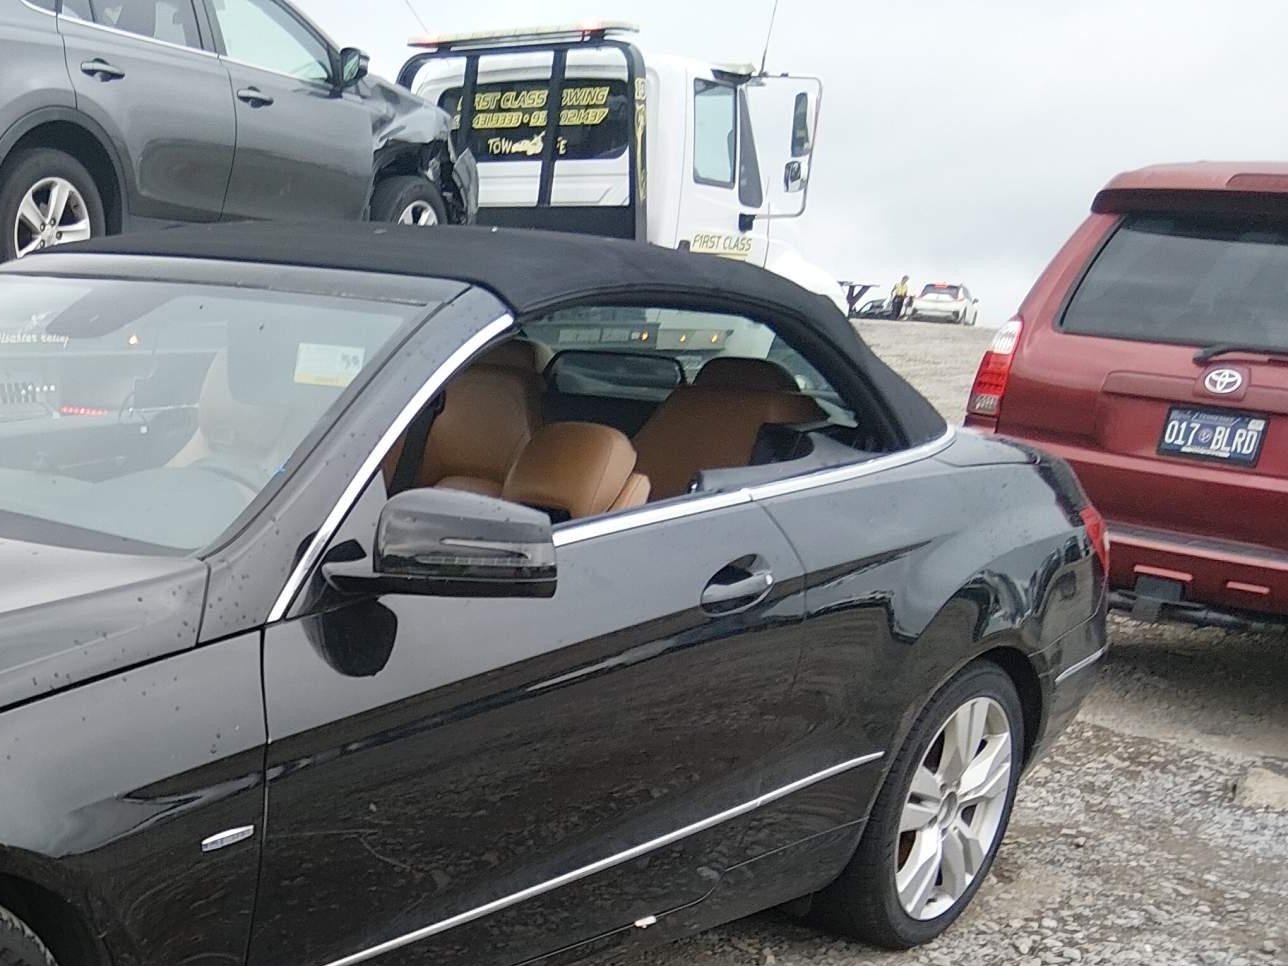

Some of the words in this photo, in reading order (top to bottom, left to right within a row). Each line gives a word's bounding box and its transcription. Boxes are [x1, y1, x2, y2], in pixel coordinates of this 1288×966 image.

[500, 89, 549, 109] CLASS
[692, 233, 722, 249] FIRST
[722, 236, 753, 252] CLASS
[1164, 420, 1201, 446] 017
[1210, 425, 1258, 455] BLRD
